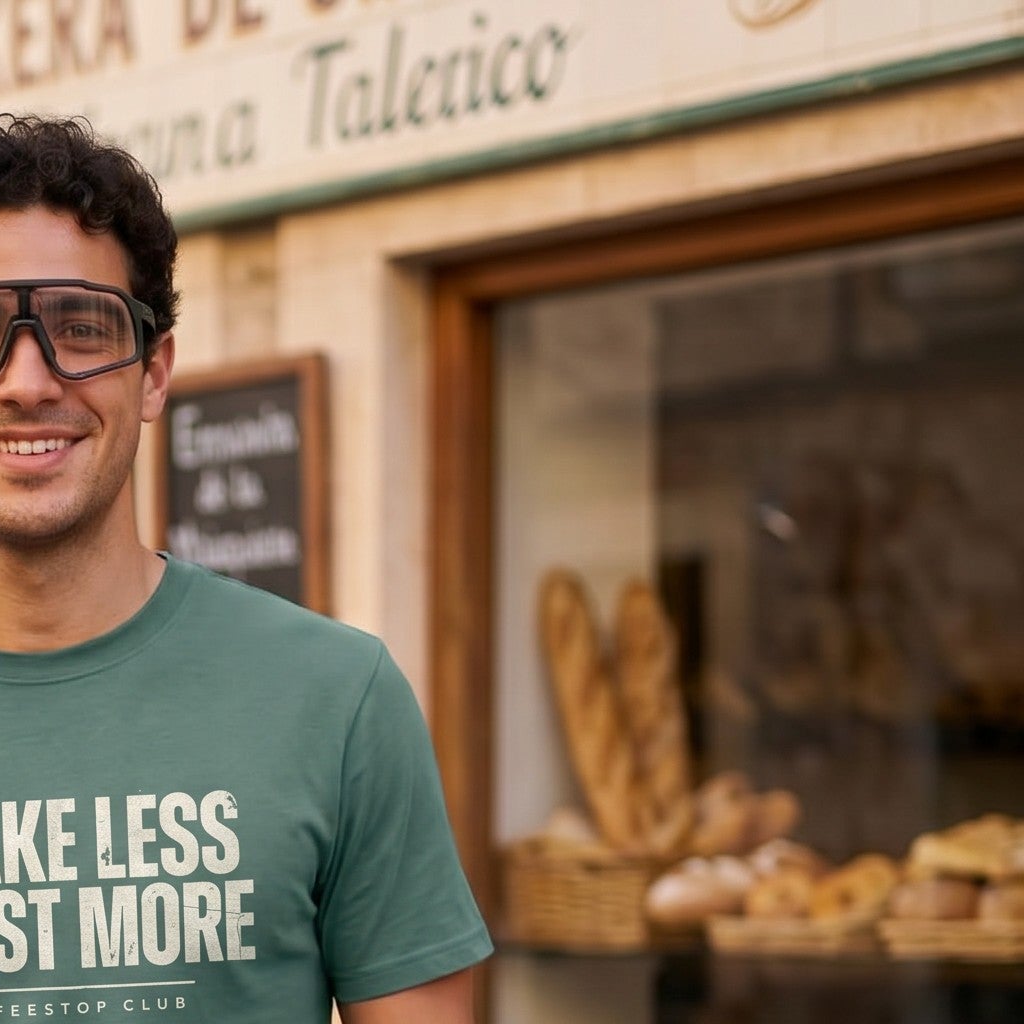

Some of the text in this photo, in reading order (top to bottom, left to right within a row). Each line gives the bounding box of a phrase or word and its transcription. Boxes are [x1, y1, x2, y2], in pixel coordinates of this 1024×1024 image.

[95, 790, 240, 879] LESS
[79, 879, 256, 968] MORE
[123, 996, 186, 1012] CLUB
